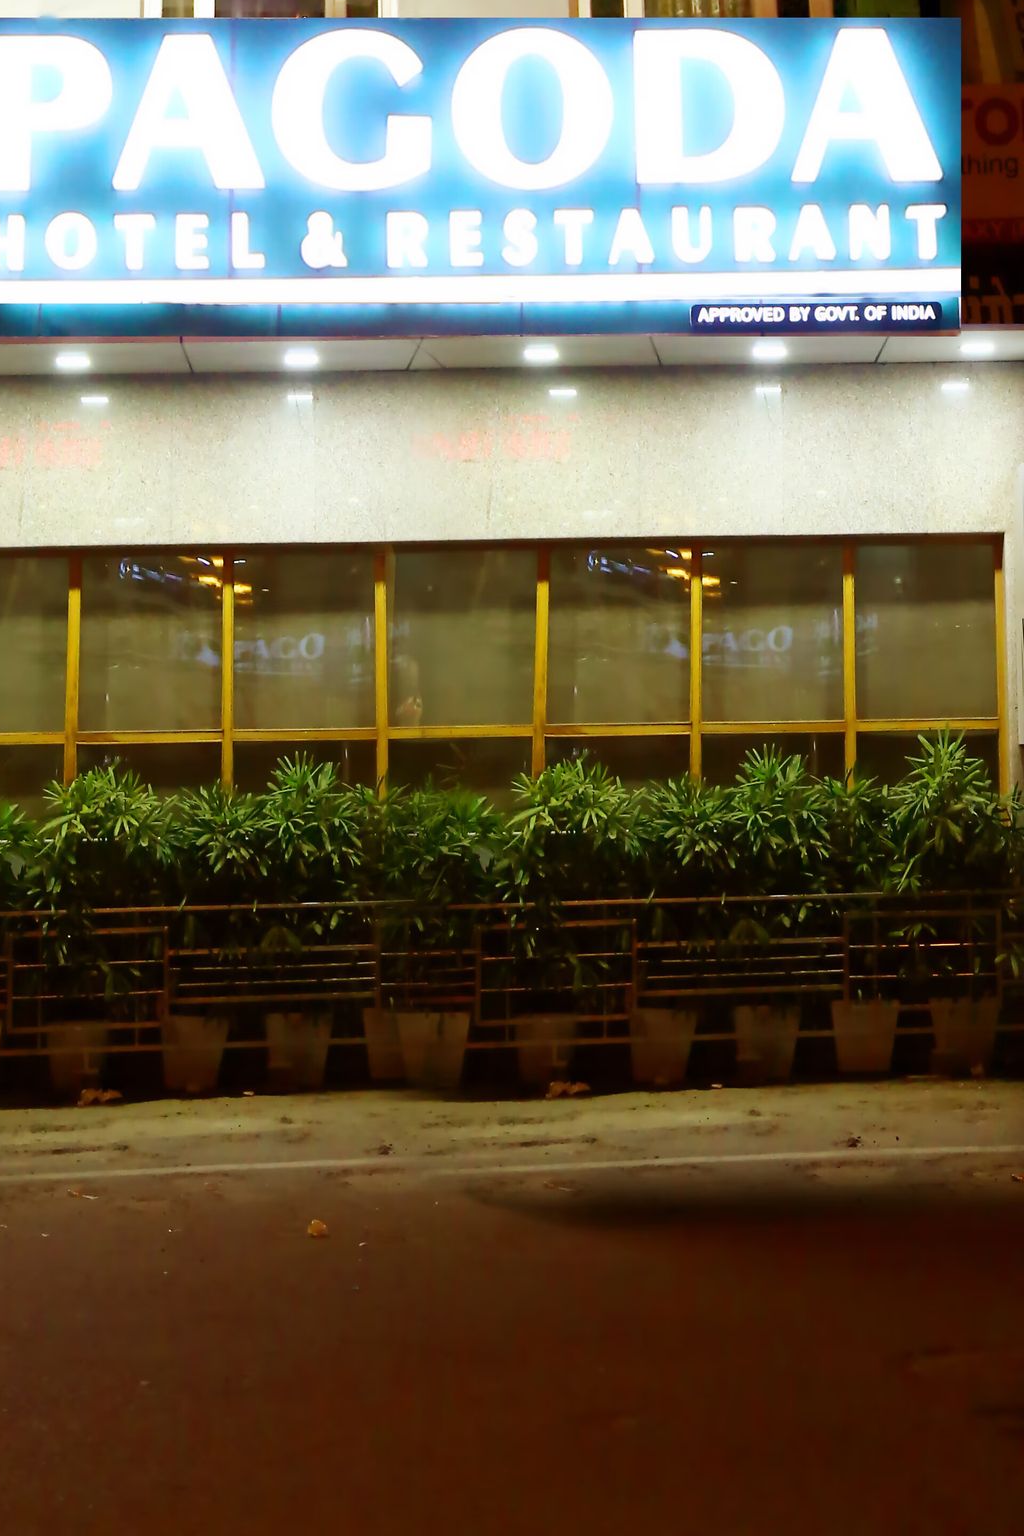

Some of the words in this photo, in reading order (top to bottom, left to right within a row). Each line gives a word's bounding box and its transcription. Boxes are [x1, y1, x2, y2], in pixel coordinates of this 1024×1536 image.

[300, 210, 349, 269] &
[385, 203, 948, 270] RESTAURANT
[697, 307, 785, 322] APPROVED
[789, 307, 810, 322] BY
[814, 306, 860, 322] GOVT.
[864, 306, 887, 321] OF
[891, 305, 936, 320] INDIA
